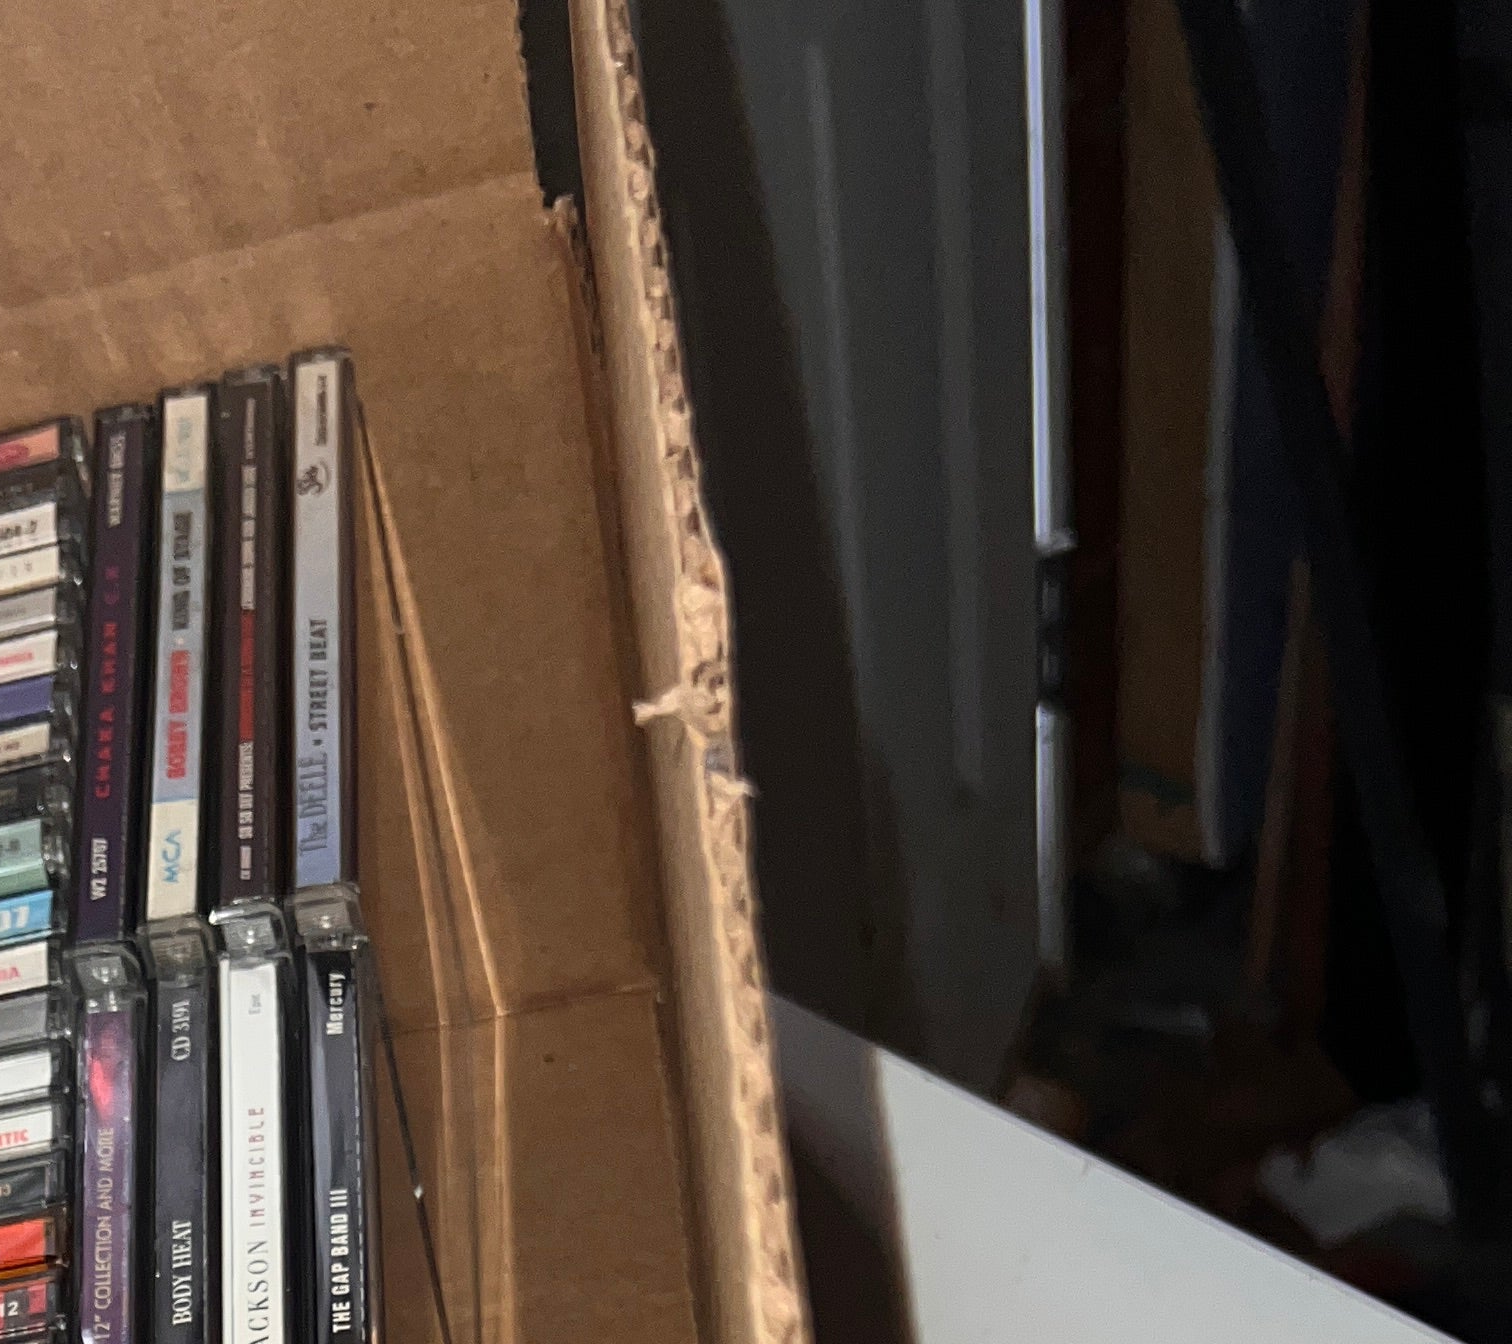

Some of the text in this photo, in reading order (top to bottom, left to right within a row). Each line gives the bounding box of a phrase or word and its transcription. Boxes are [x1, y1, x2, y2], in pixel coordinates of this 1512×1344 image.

[308, 618, 328, 732] STREET BEAT
[325, 972, 347, 1037] Mercury
[96, 1126, 115, 1173] MORE
[248, 1106, 265, 1228] INVINCIBLE
[96, 1178, 113, 1210] AND
[329, 1188, 349, 1209] III
[172, 1220, 193, 1271] HEAT
[329, 1212, 350, 1257] BAND
[94, 1213, 113, 1311] COLLECTION
[330, 1261, 351, 1297] GAP
[172, 1273, 193, 1326] BODY
[331, 1300, 352, 1335] THE
